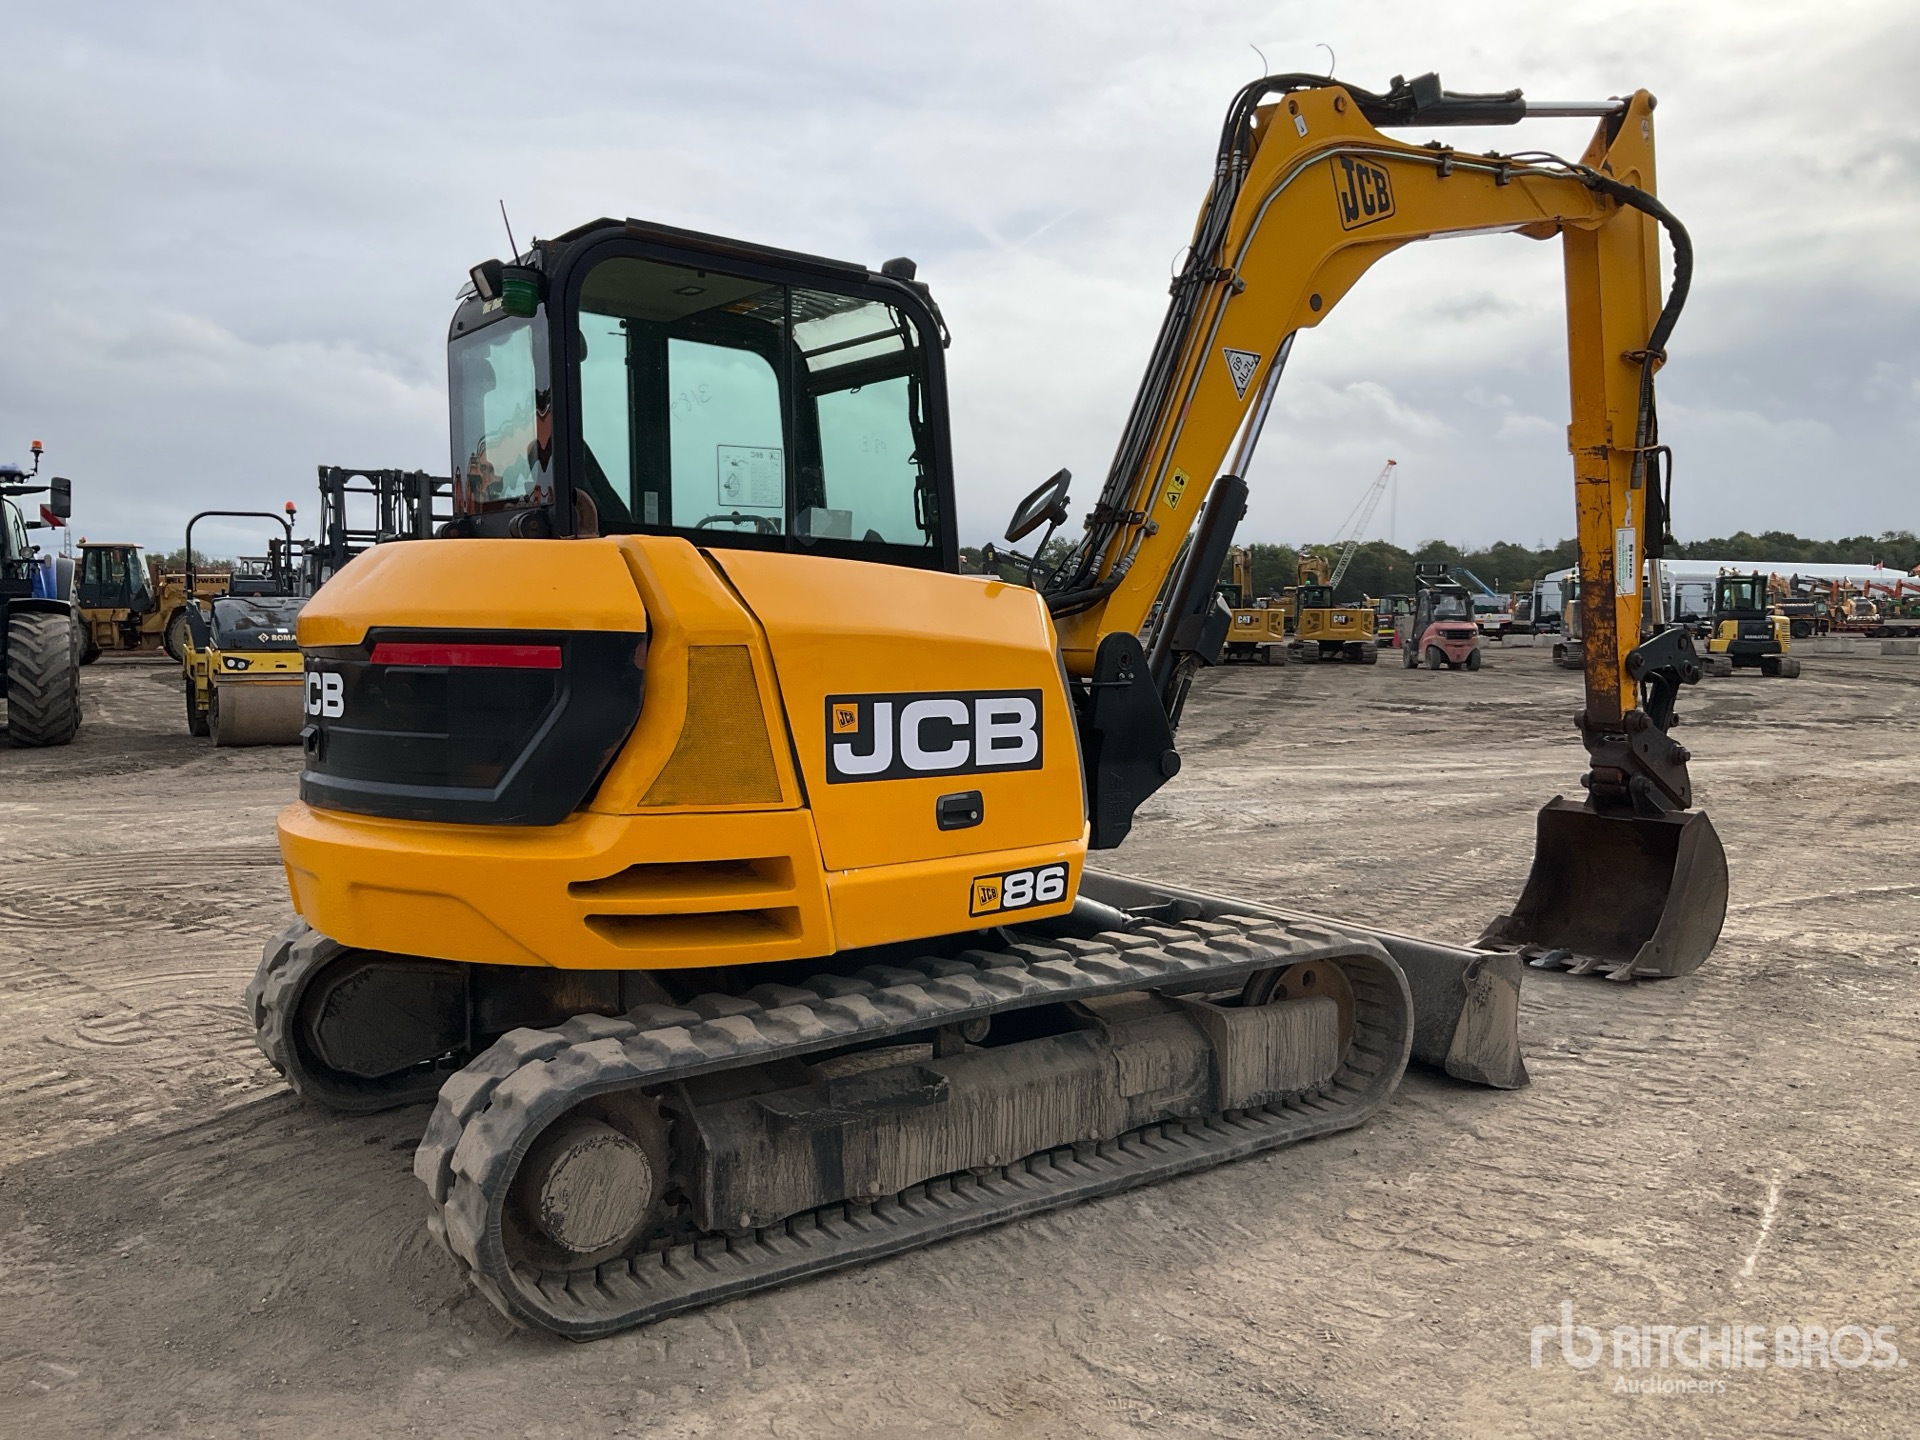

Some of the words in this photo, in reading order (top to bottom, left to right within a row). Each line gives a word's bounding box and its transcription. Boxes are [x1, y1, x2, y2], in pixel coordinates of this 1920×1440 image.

[1340, 156, 1390, 223] JCB
[1237, 615, 1251, 624] CAT
[1333, 615, 1347, 623] CAT
[840, 711, 854, 725] JCB
[833, 697, 1038, 775] JCB
[981, 887, 997, 903] JCB
[1003, 866, 1065, 908] 86
